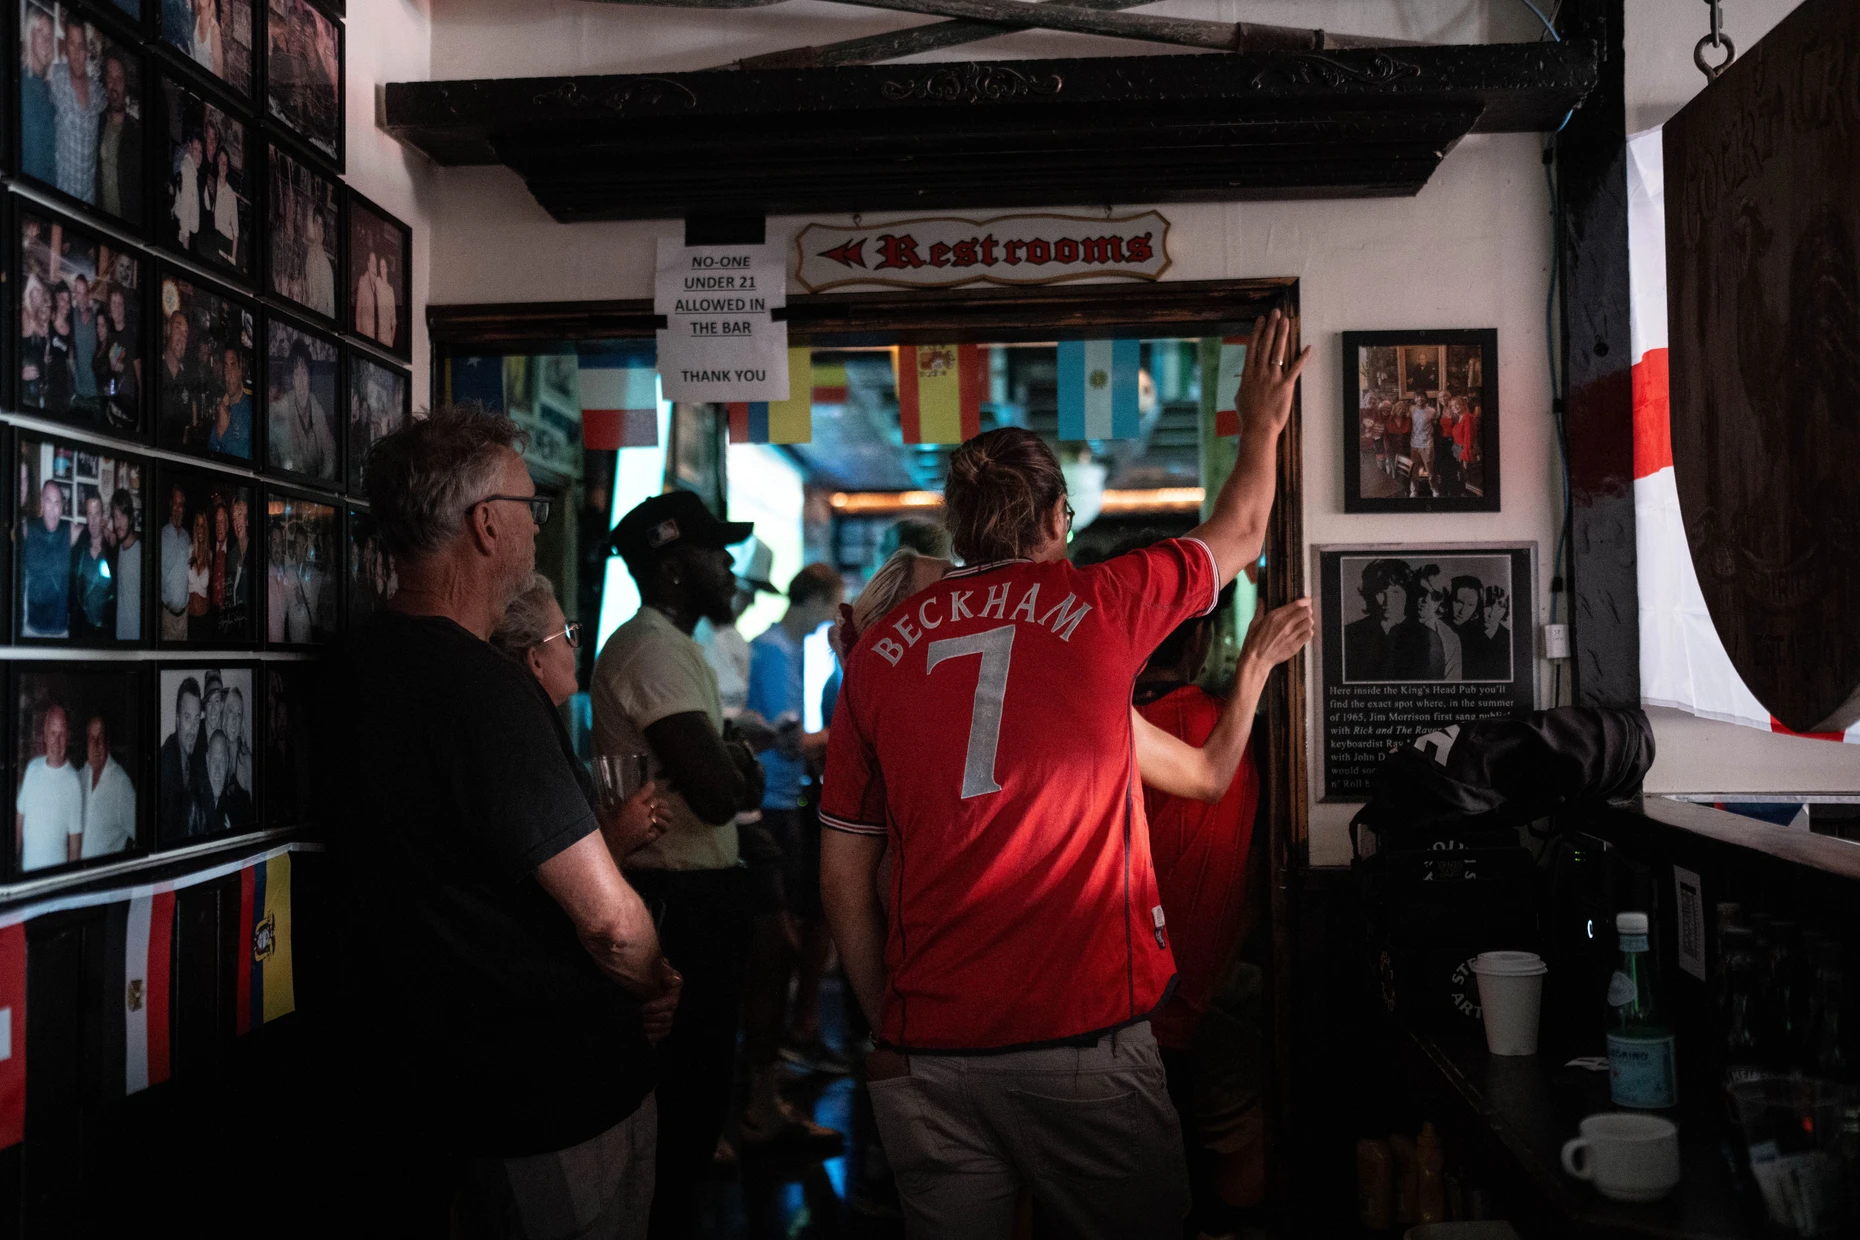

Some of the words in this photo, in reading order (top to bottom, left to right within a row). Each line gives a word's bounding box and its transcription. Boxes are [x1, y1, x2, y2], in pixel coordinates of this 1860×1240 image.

[874, 231, 1153, 270] Restrooms
[692, 256, 750, 268] NO-ONE
[684, 277, 734, 289] UNDER
[739, 276, 756, 288] 21
[674, 299, 745, 312] ALLOWED
[750, 299, 765, 311] IN
[690, 322, 718, 334] THE
[722, 321, 751, 334] BAR
[682, 370, 730, 382] THANK
[735, 369, 766, 381] YOU
[870, 581, 1093, 668] BECKHAM
[1329, 686, 1352, 695] Here
[1354, 686, 1381, 695] inside
[1384, 686, 1398, 695] the
[1401, 685, 1430, 697] King's
[1432, 685, 1456, 694] Head
[1459, 685, 1477, 694] Pub
[1329, 699, 1348, 709] find
[1351, 699, 1365, 708] the
[1367, 700, 1392, 708] exact
[1394, 700, 1413, 710] spot
[1416, 698, 1446, 708] where,
[1449, 699, 1458, 707] in
[1461, 698, 1475, 707] the
[1477, 699, 1514, 707] summer
[926, 623, 1017, 800] 7
[1329, 712, 1340, 722] of
[1369, 712, 1386, 721] Jim
[1388, 712, 1430, 721] Morrison
[1433, 711, 1453, 721] first
[1455, 712, 1476, 721] sang
[1330, 725, 1351, 735] with
[1353, 726, 1373, 735] Rick
[1375, 726, 1394, 735] and
[1395, 725, 1412, 735] The
[1330, 739, 1383, 750] keyboardist
[1330, 753, 1351, 762] with
[1353, 752, 1375, 761] John
[1330, 765, 1360, 775] would
[1343, 779, 1362, 788] Roll
